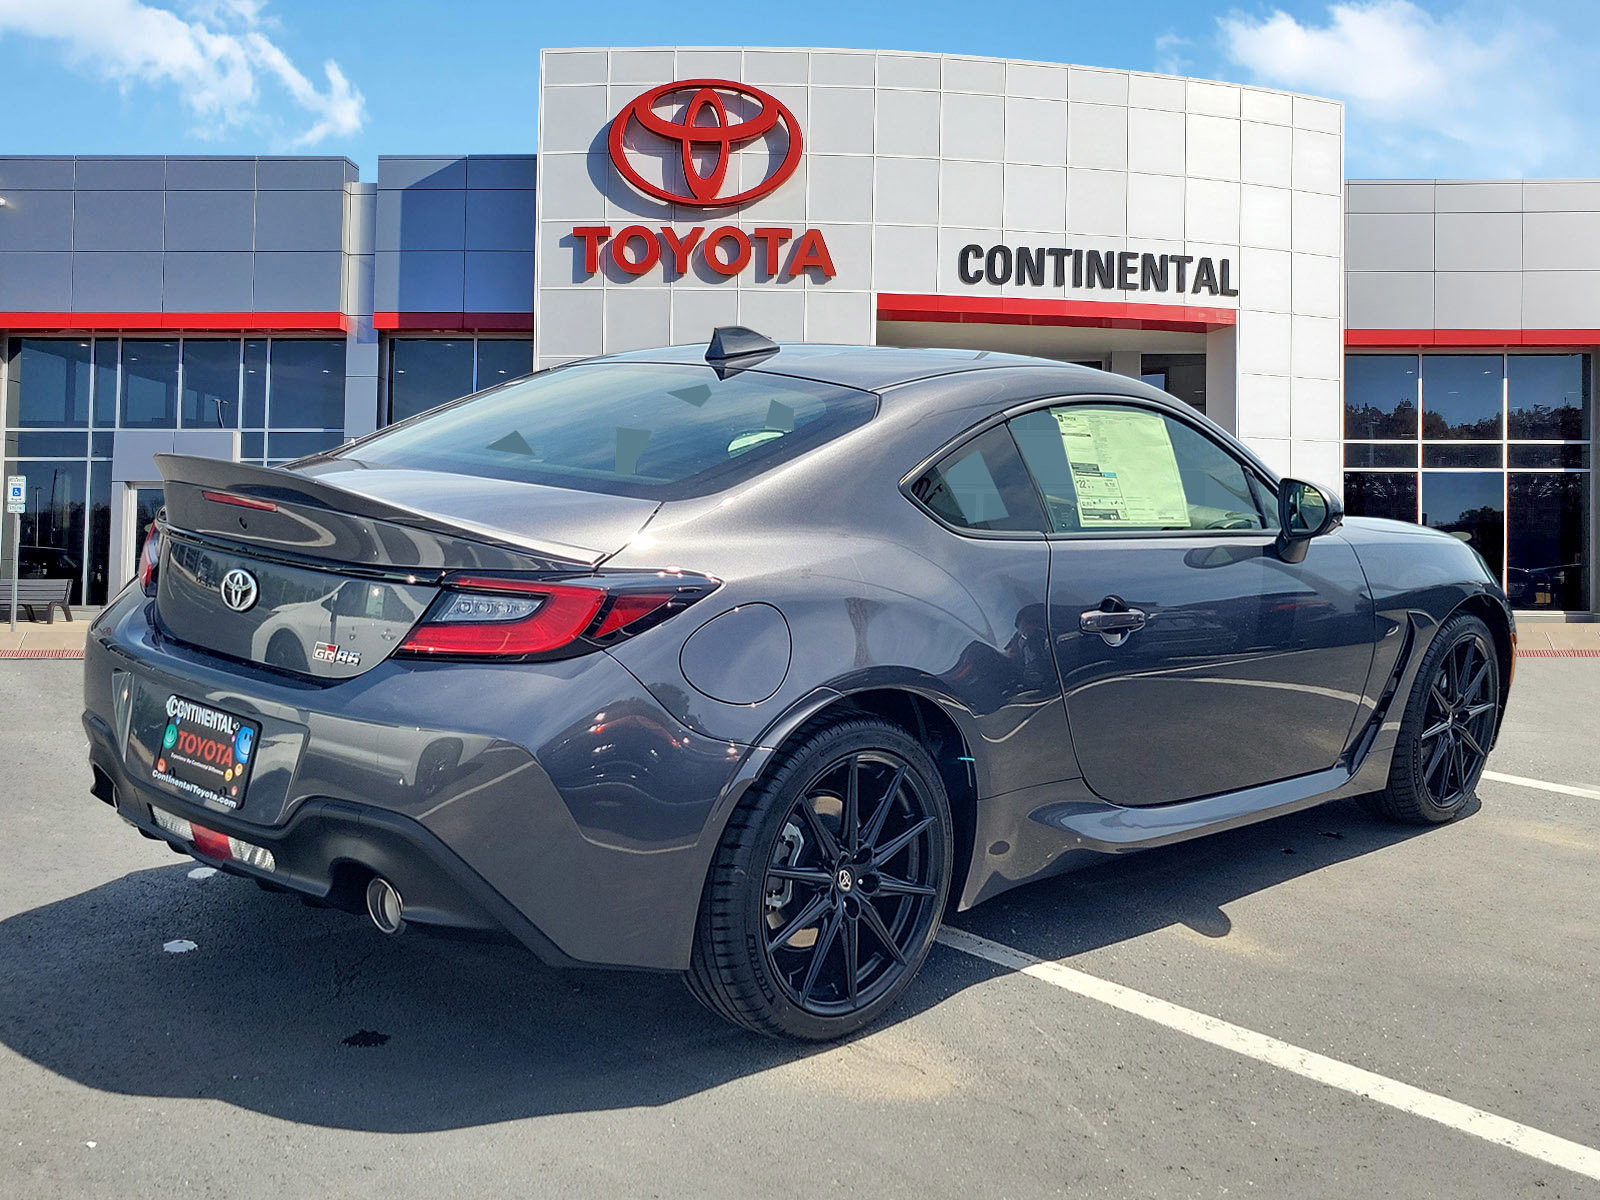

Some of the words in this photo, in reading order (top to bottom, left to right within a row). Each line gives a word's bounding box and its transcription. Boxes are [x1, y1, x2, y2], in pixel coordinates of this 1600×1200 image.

[573, 226, 836, 278] TOYOTA
[958, 243, 1239, 298] CONTINENTAL
[166, 695, 234, 735] CONTINENTAL
[178, 730, 233, 768] TOYOTA
[152, 769, 237, 809] ContinentalToyota.com
